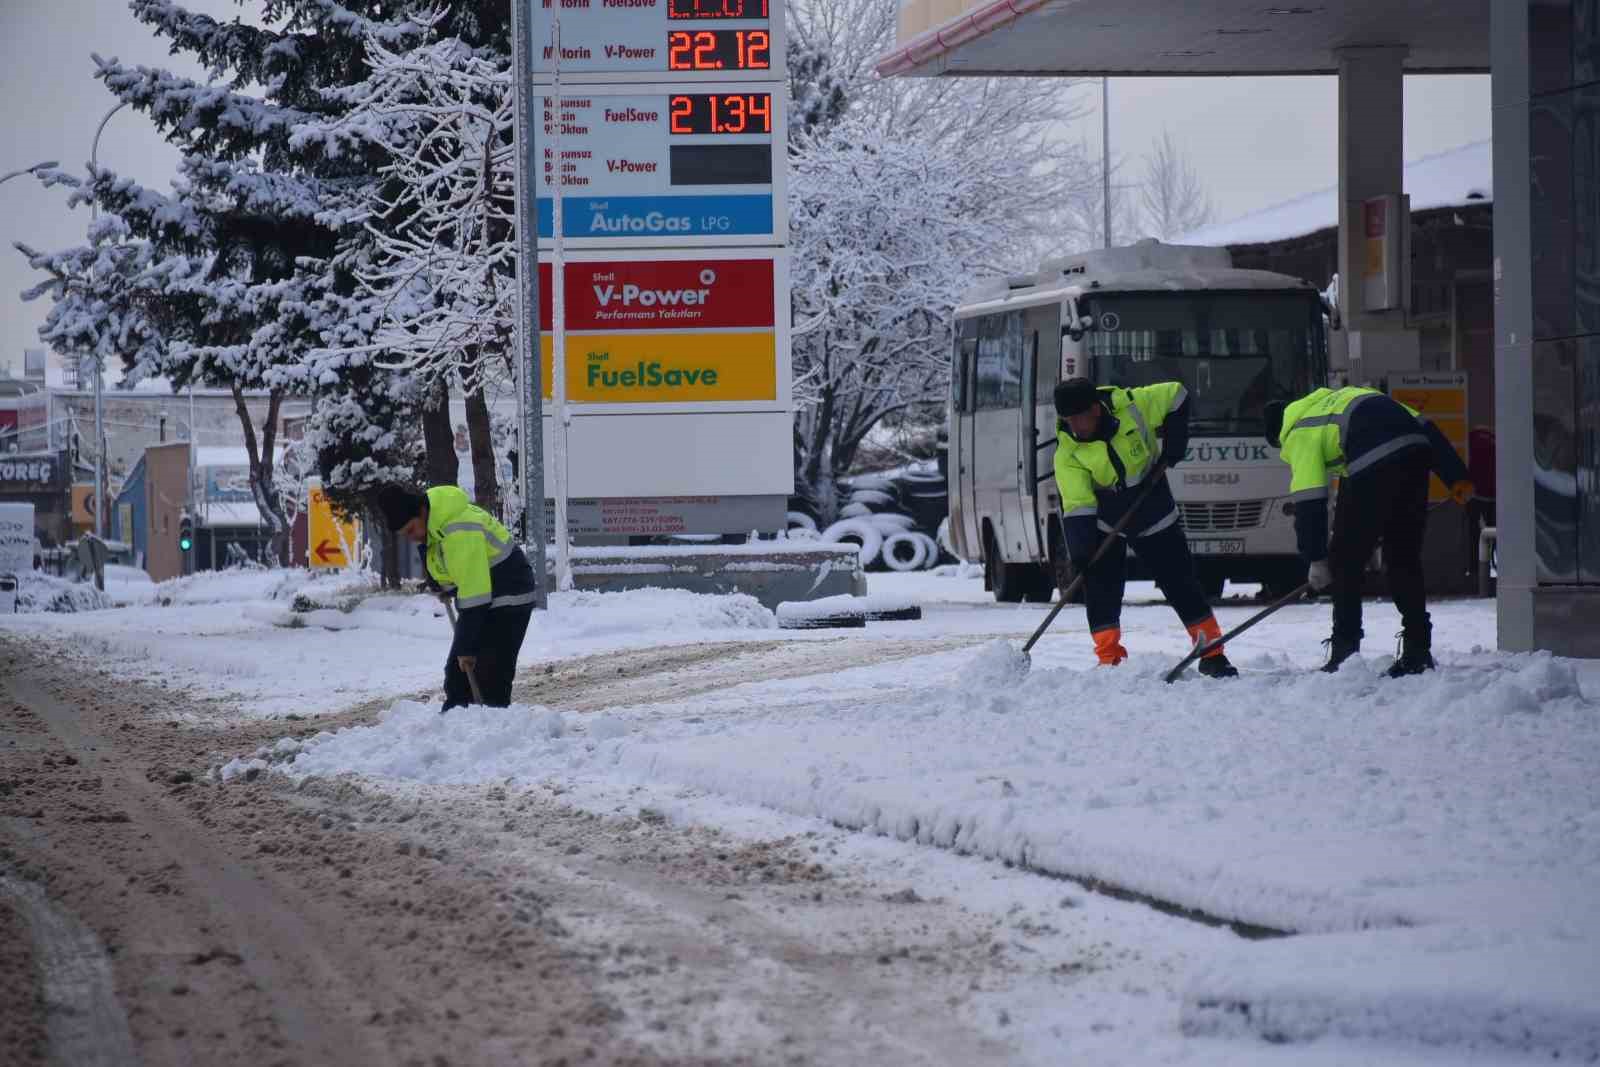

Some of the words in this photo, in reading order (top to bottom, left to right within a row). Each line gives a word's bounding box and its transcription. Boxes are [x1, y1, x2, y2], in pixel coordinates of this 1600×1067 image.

[542, 0, 590, 8] Mtorin
[543, 47, 591, 59] Mtorin
[604, 46, 656, 58] V-Power
[670, 31, 769, 69] 22.12
[543, 111, 576, 121] Bzin
[604, 109, 659, 122] FuelSave
[671, 96, 771, 133] 21.34
[544, 161, 577, 172] Bzin
[606, 159, 657, 173] V-Power
[590, 212, 692, 232] AutoGas
[701, 216, 730, 231] LPG
[592, 273, 615, 281] Shell
[593, 285, 710, 306] V-Power
[595, 311, 655, 320] Performans
[586, 352, 609, 360] Shell
[587, 361, 718, 387] FuelSave
